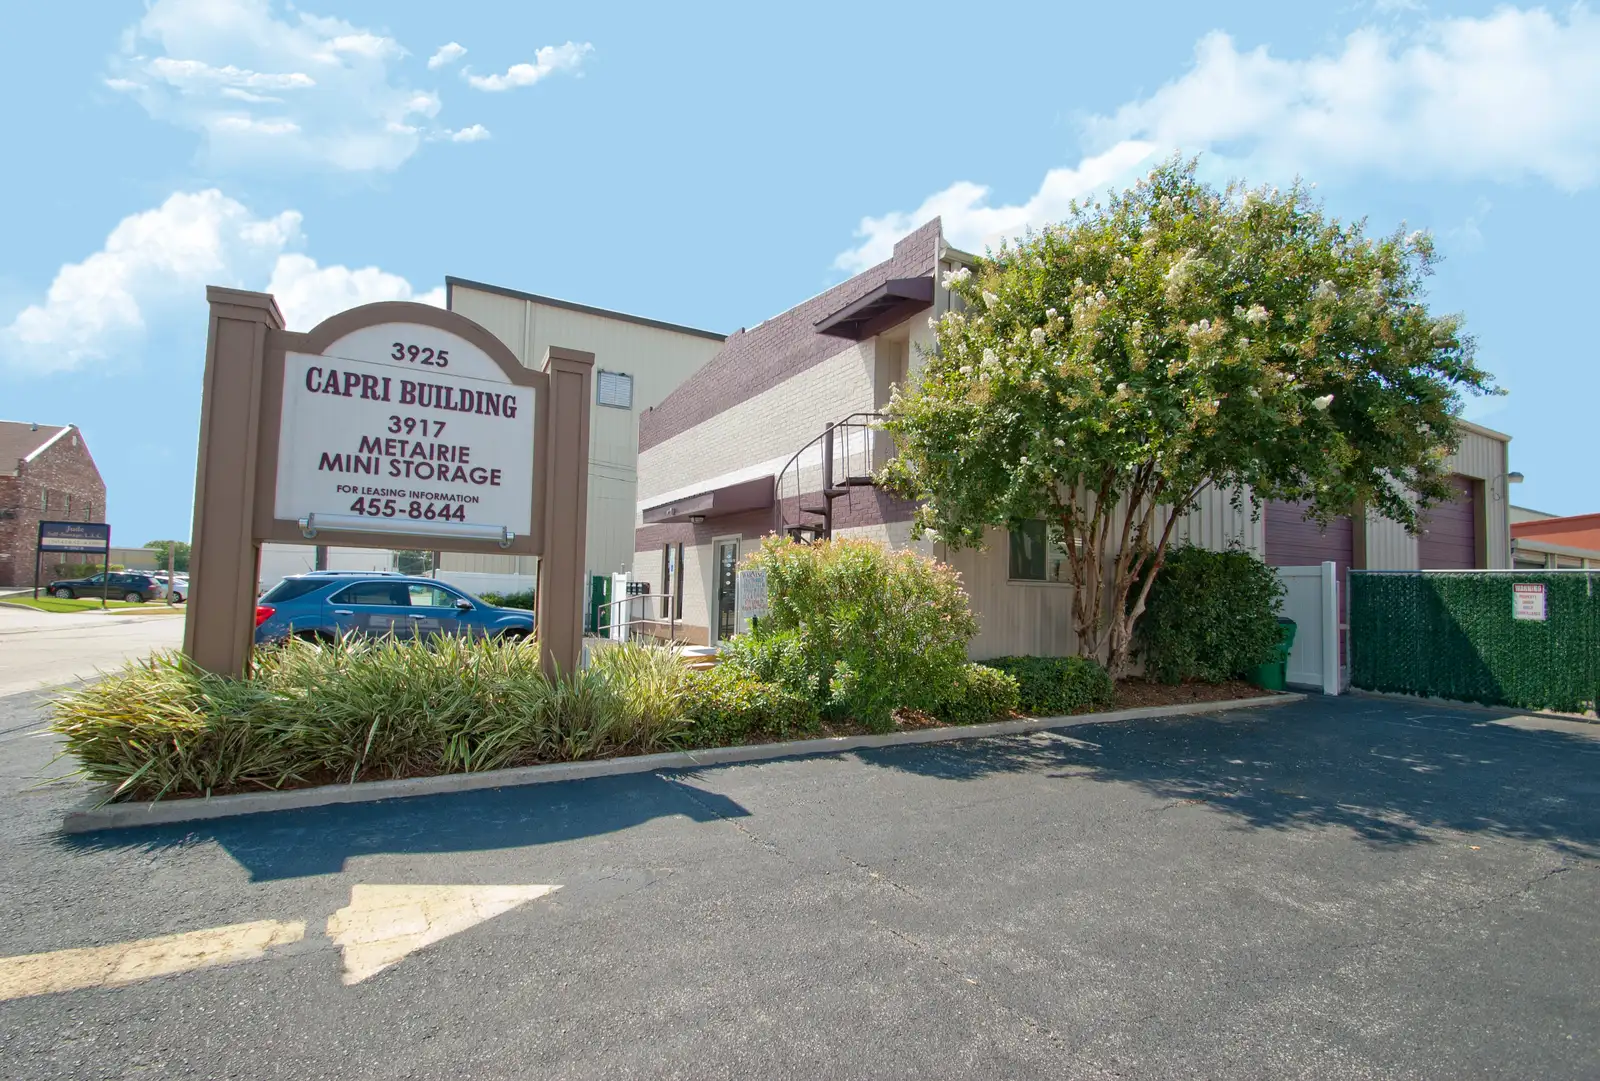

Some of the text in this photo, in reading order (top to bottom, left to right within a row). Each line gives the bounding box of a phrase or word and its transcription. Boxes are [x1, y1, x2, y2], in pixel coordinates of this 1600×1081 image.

[391, 342, 449, 368] 3925
[306, 366, 517, 418] CAPRI BUILDING
[388, 415, 446, 438] 3917
[358, 436, 470, 464] METAIRIE
[318, 453, 501, 486] MINI STORAGE
[337, 484, 479, 504] FOR LEASING INFORMATION
[350, 497, 465, 522] 455-8644
